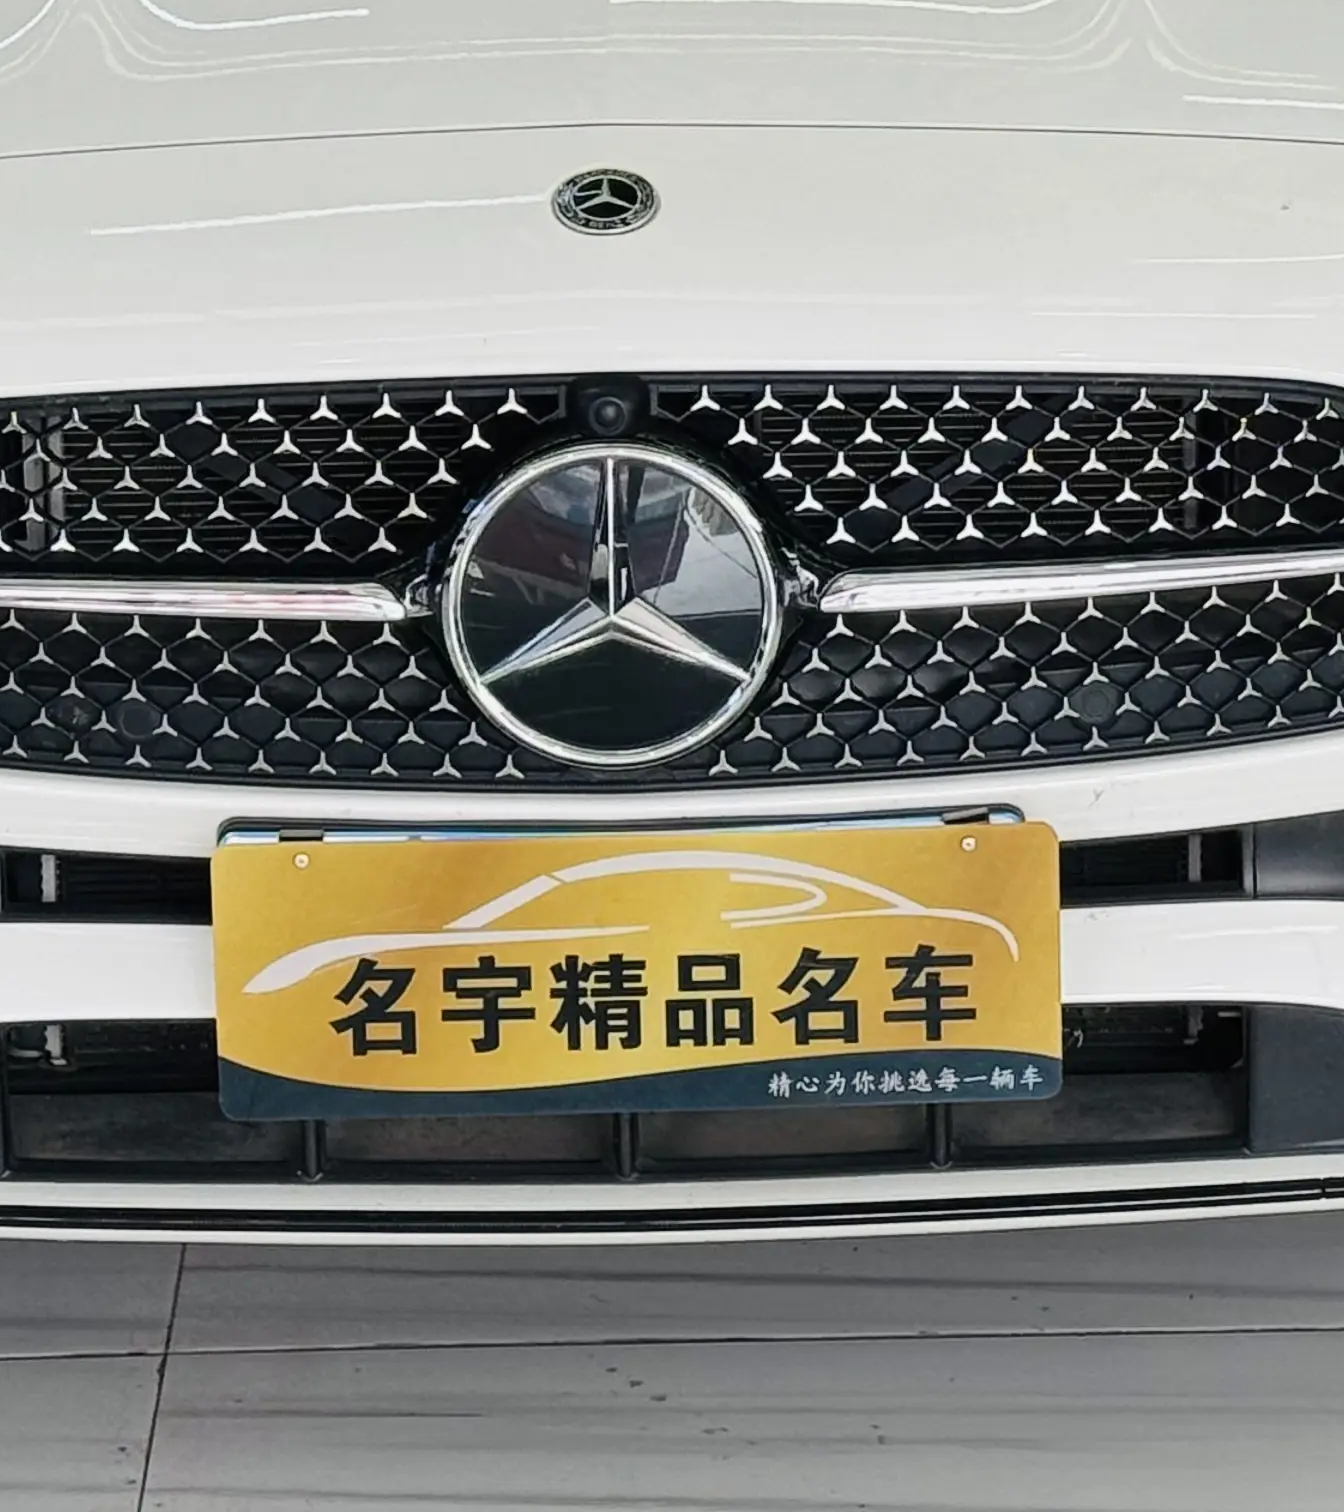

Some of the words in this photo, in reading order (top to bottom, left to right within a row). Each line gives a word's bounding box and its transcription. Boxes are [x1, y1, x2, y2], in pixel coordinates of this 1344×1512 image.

[329, 944, 978, 1057] 名宇精品名车
[768, 1064, 1044, 1098] 精心为你挑选每一辆车
